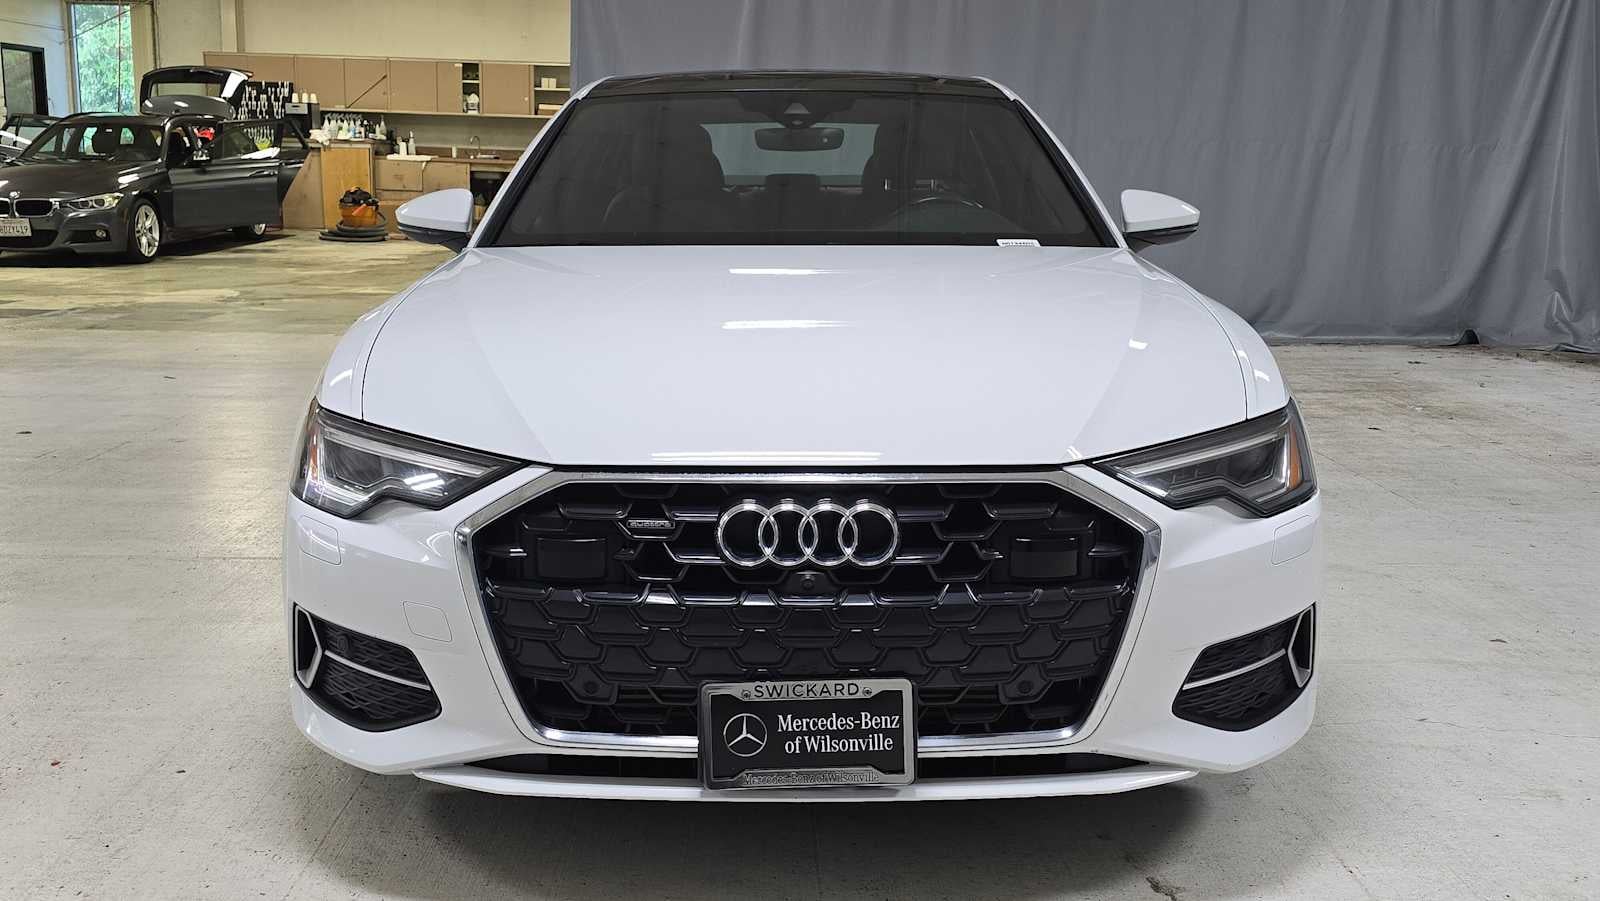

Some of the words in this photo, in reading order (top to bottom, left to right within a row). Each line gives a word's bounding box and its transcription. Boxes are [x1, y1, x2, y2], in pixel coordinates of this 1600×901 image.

[754, 682, 859, 697] SWICKARD
[777, 712, 900, 732] Mercedes-Benz
[784, 735, 803, 754] of
[803, 733, 893, 753] Wilsonville
[827, 771, 879, 784] Wilsonville
